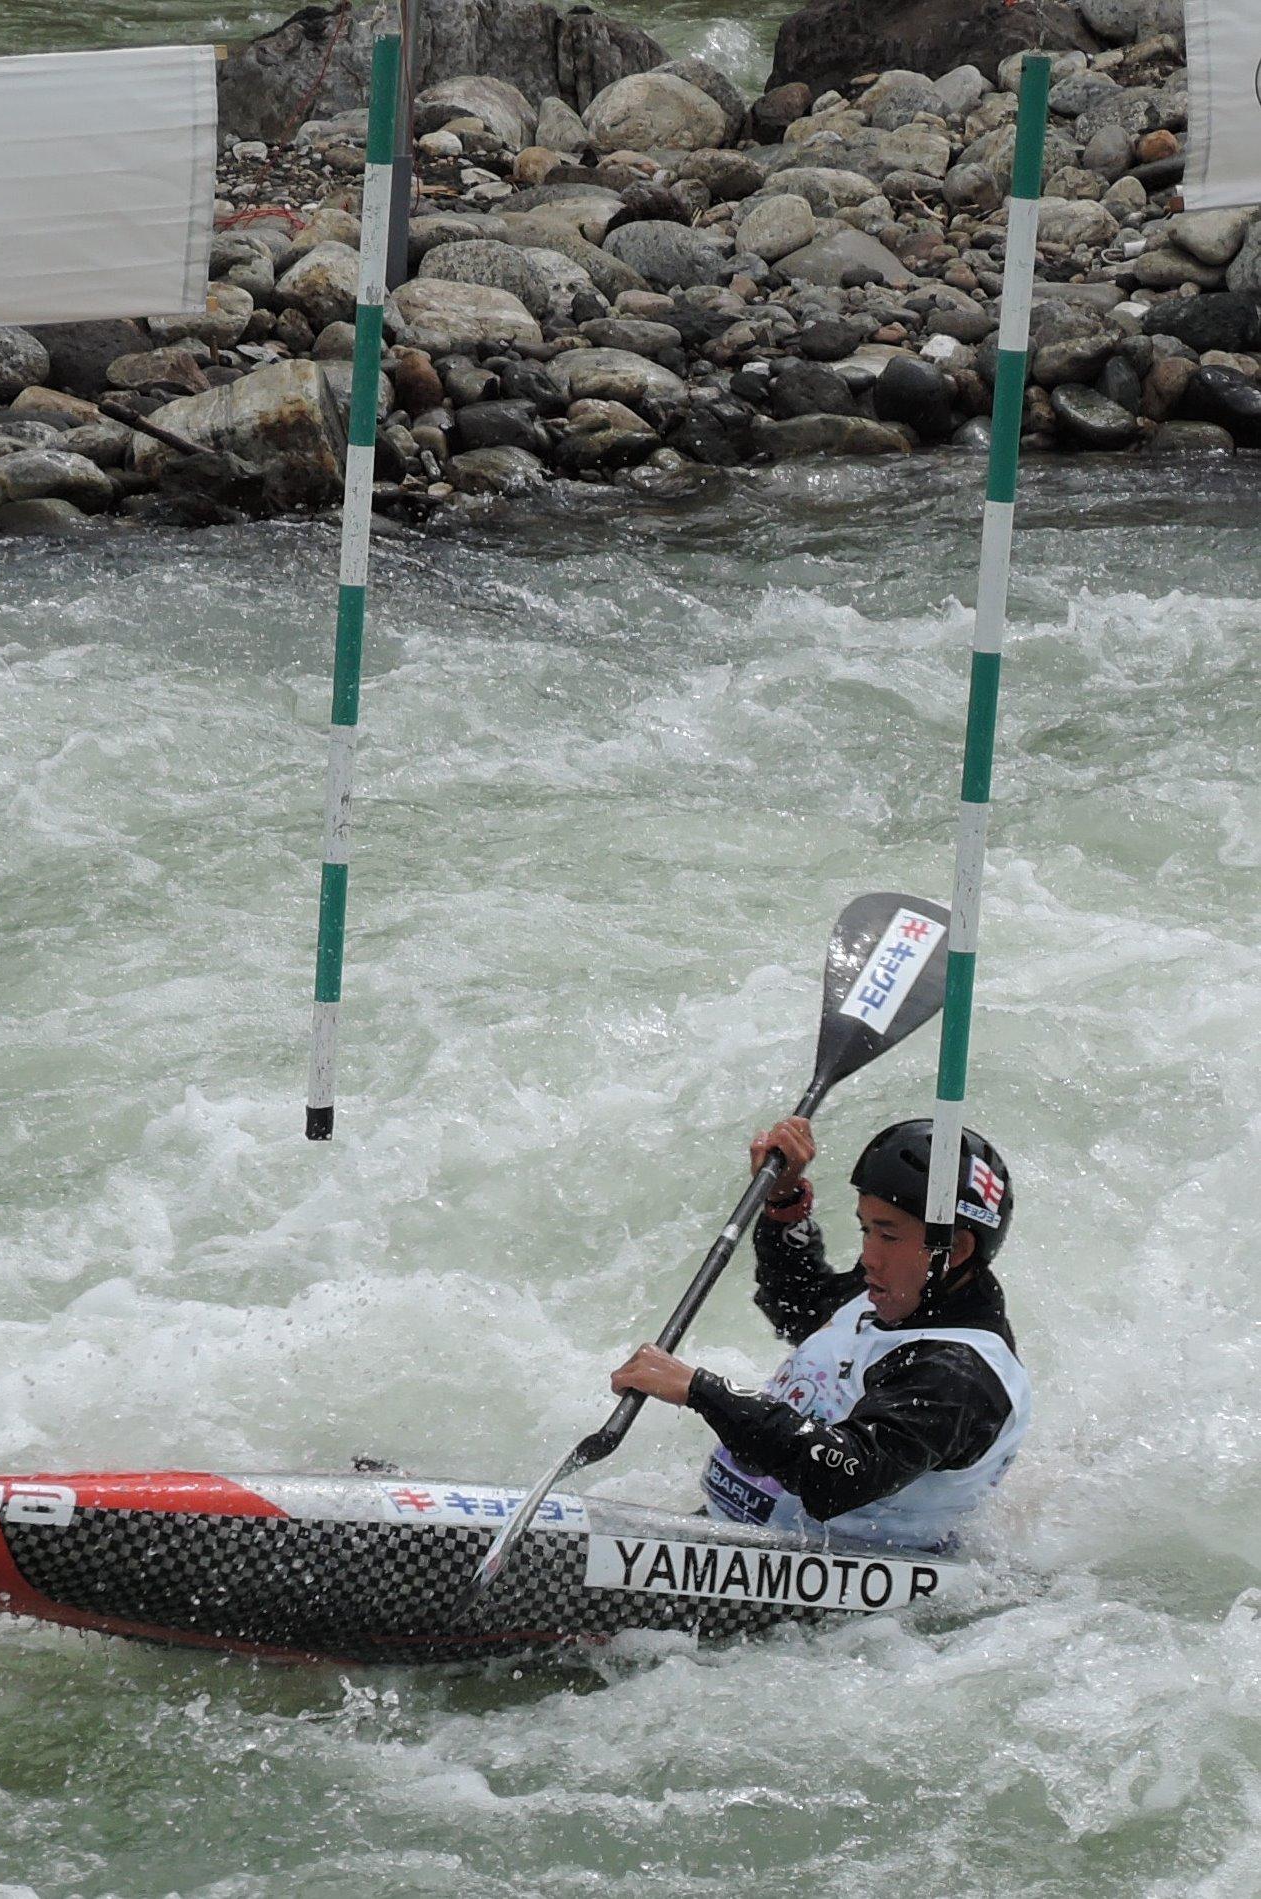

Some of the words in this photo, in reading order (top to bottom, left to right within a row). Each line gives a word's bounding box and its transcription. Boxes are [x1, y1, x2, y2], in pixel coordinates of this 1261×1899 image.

[709, 1462, 761, 1509] BARU
[614, 1539, 893, 1608] YAMAMOTO
[909, 1565, 939, 1601] R
